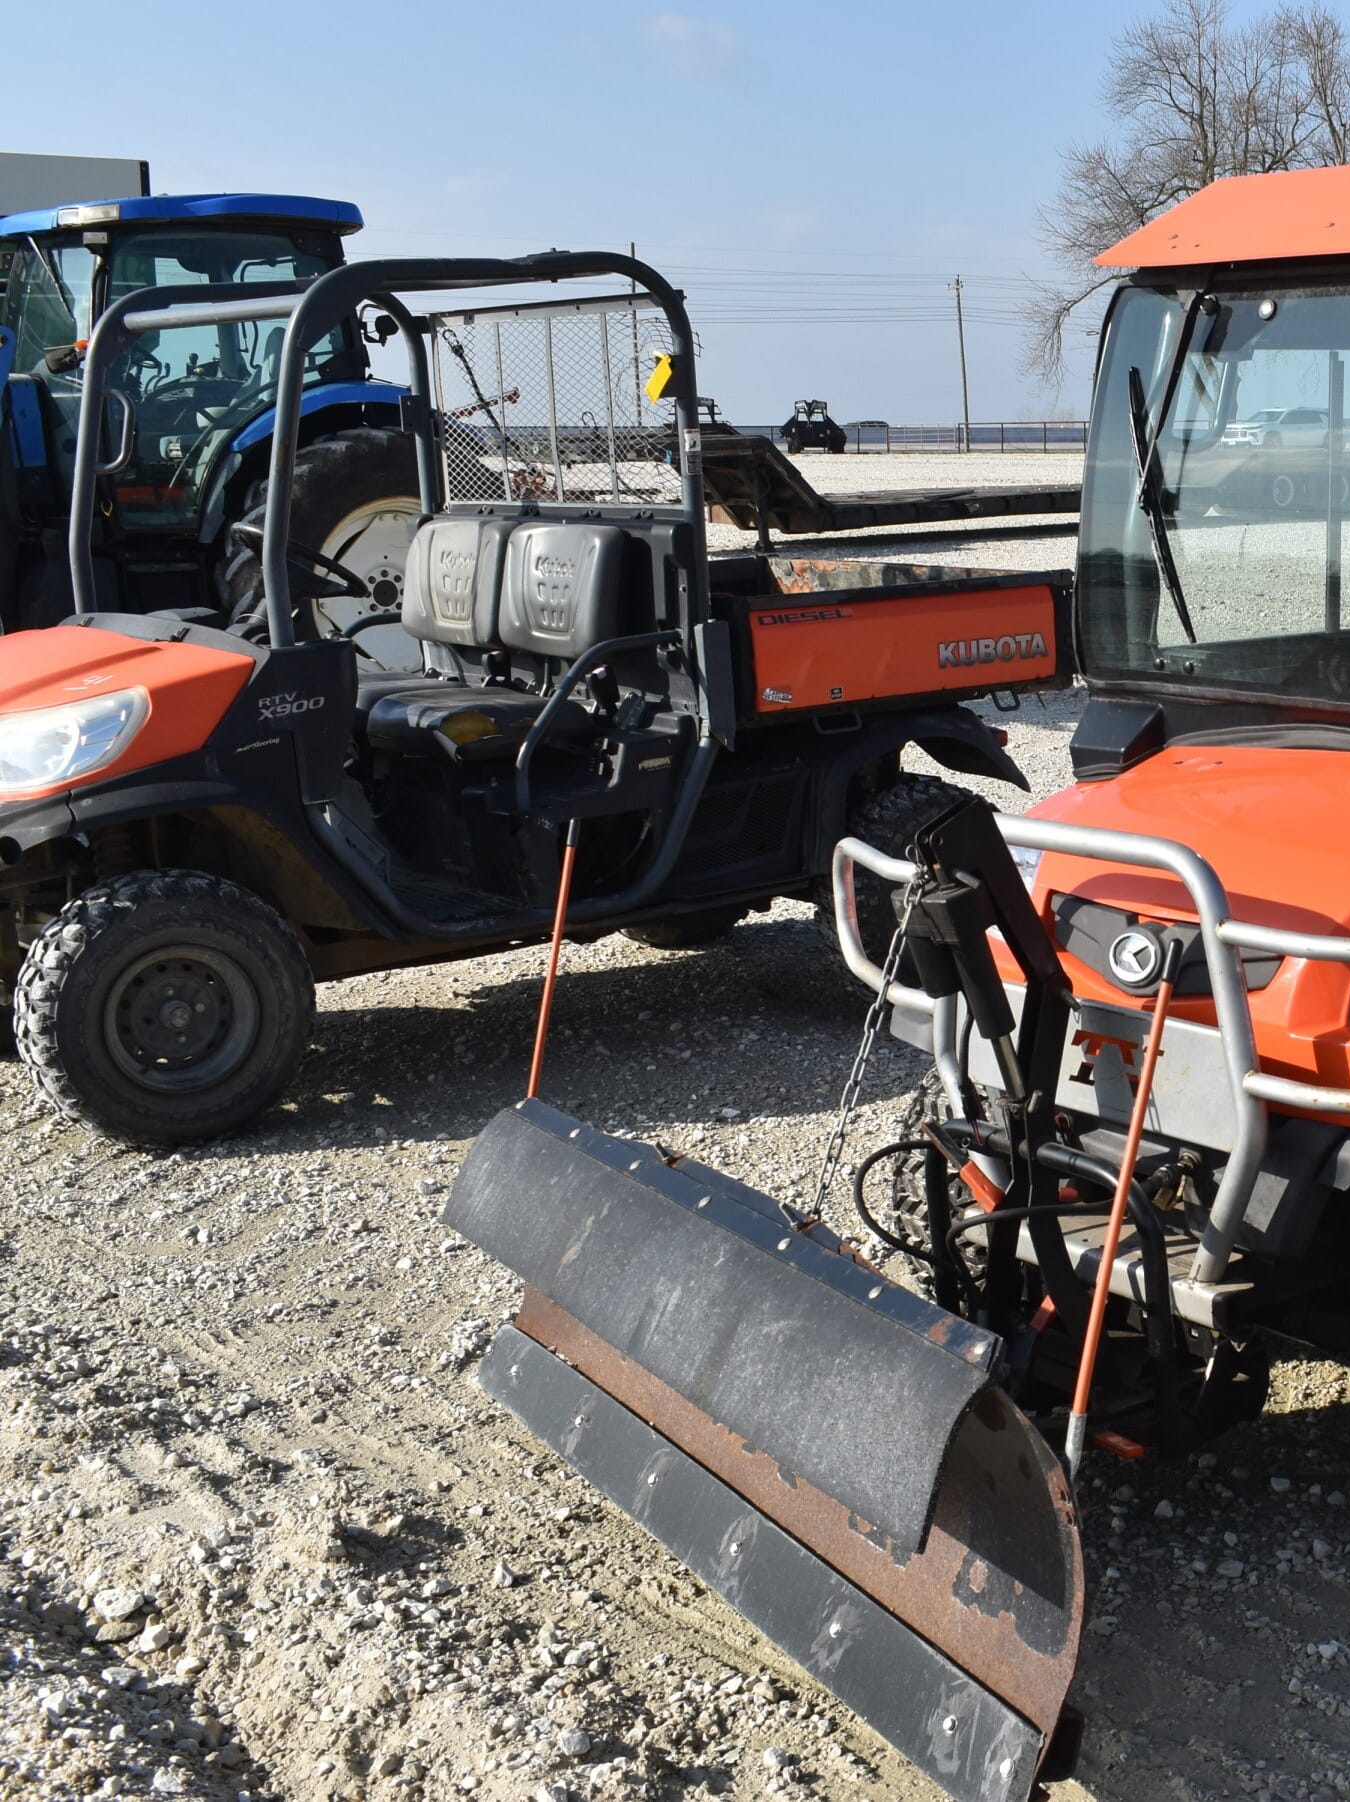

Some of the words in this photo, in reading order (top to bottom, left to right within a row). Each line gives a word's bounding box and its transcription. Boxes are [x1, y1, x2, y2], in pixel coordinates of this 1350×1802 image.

[758, 607, 853, 626] DIESEL
[938, 632, 1048, 669] KUBOTA
[258, 691, 296, 708] RTV
[258, 696, 325, 721] X900
